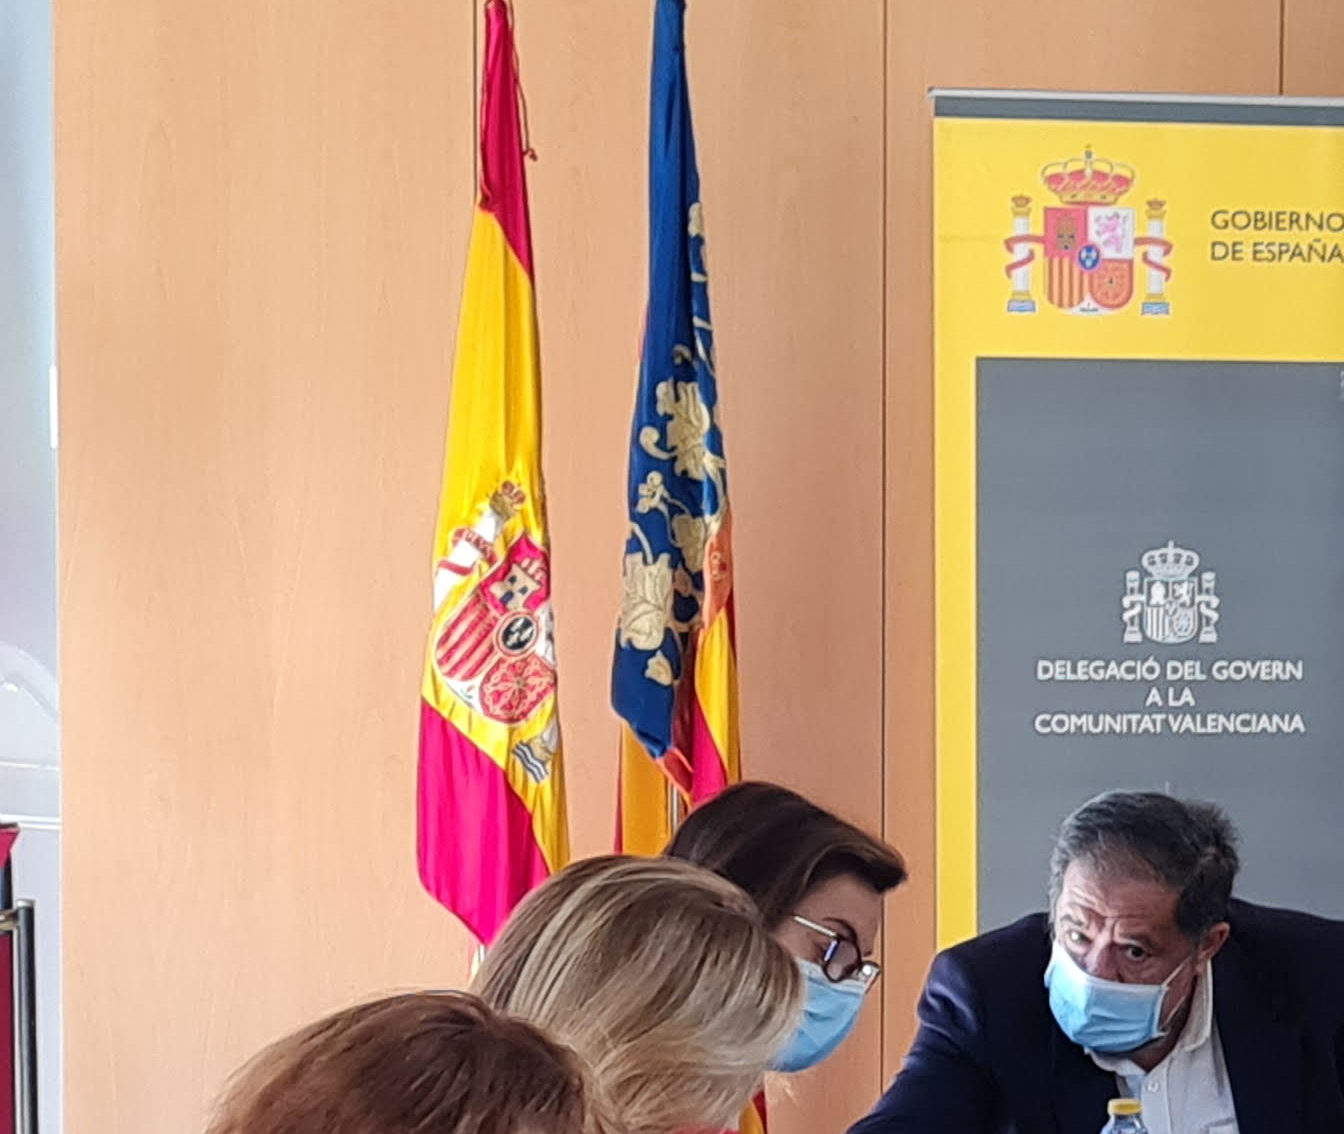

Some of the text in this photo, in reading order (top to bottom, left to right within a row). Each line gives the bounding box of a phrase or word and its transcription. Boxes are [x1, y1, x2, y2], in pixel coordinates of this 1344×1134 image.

[1210, 240, 1244, 262] DE
[1036, 655, 1303, 681] DELEGACIÓ DEL GOVERN
[1145, 686, 1196, 707] A LA
[1034, 713, 1306, 734] COMUNITAT VALENCIANA
